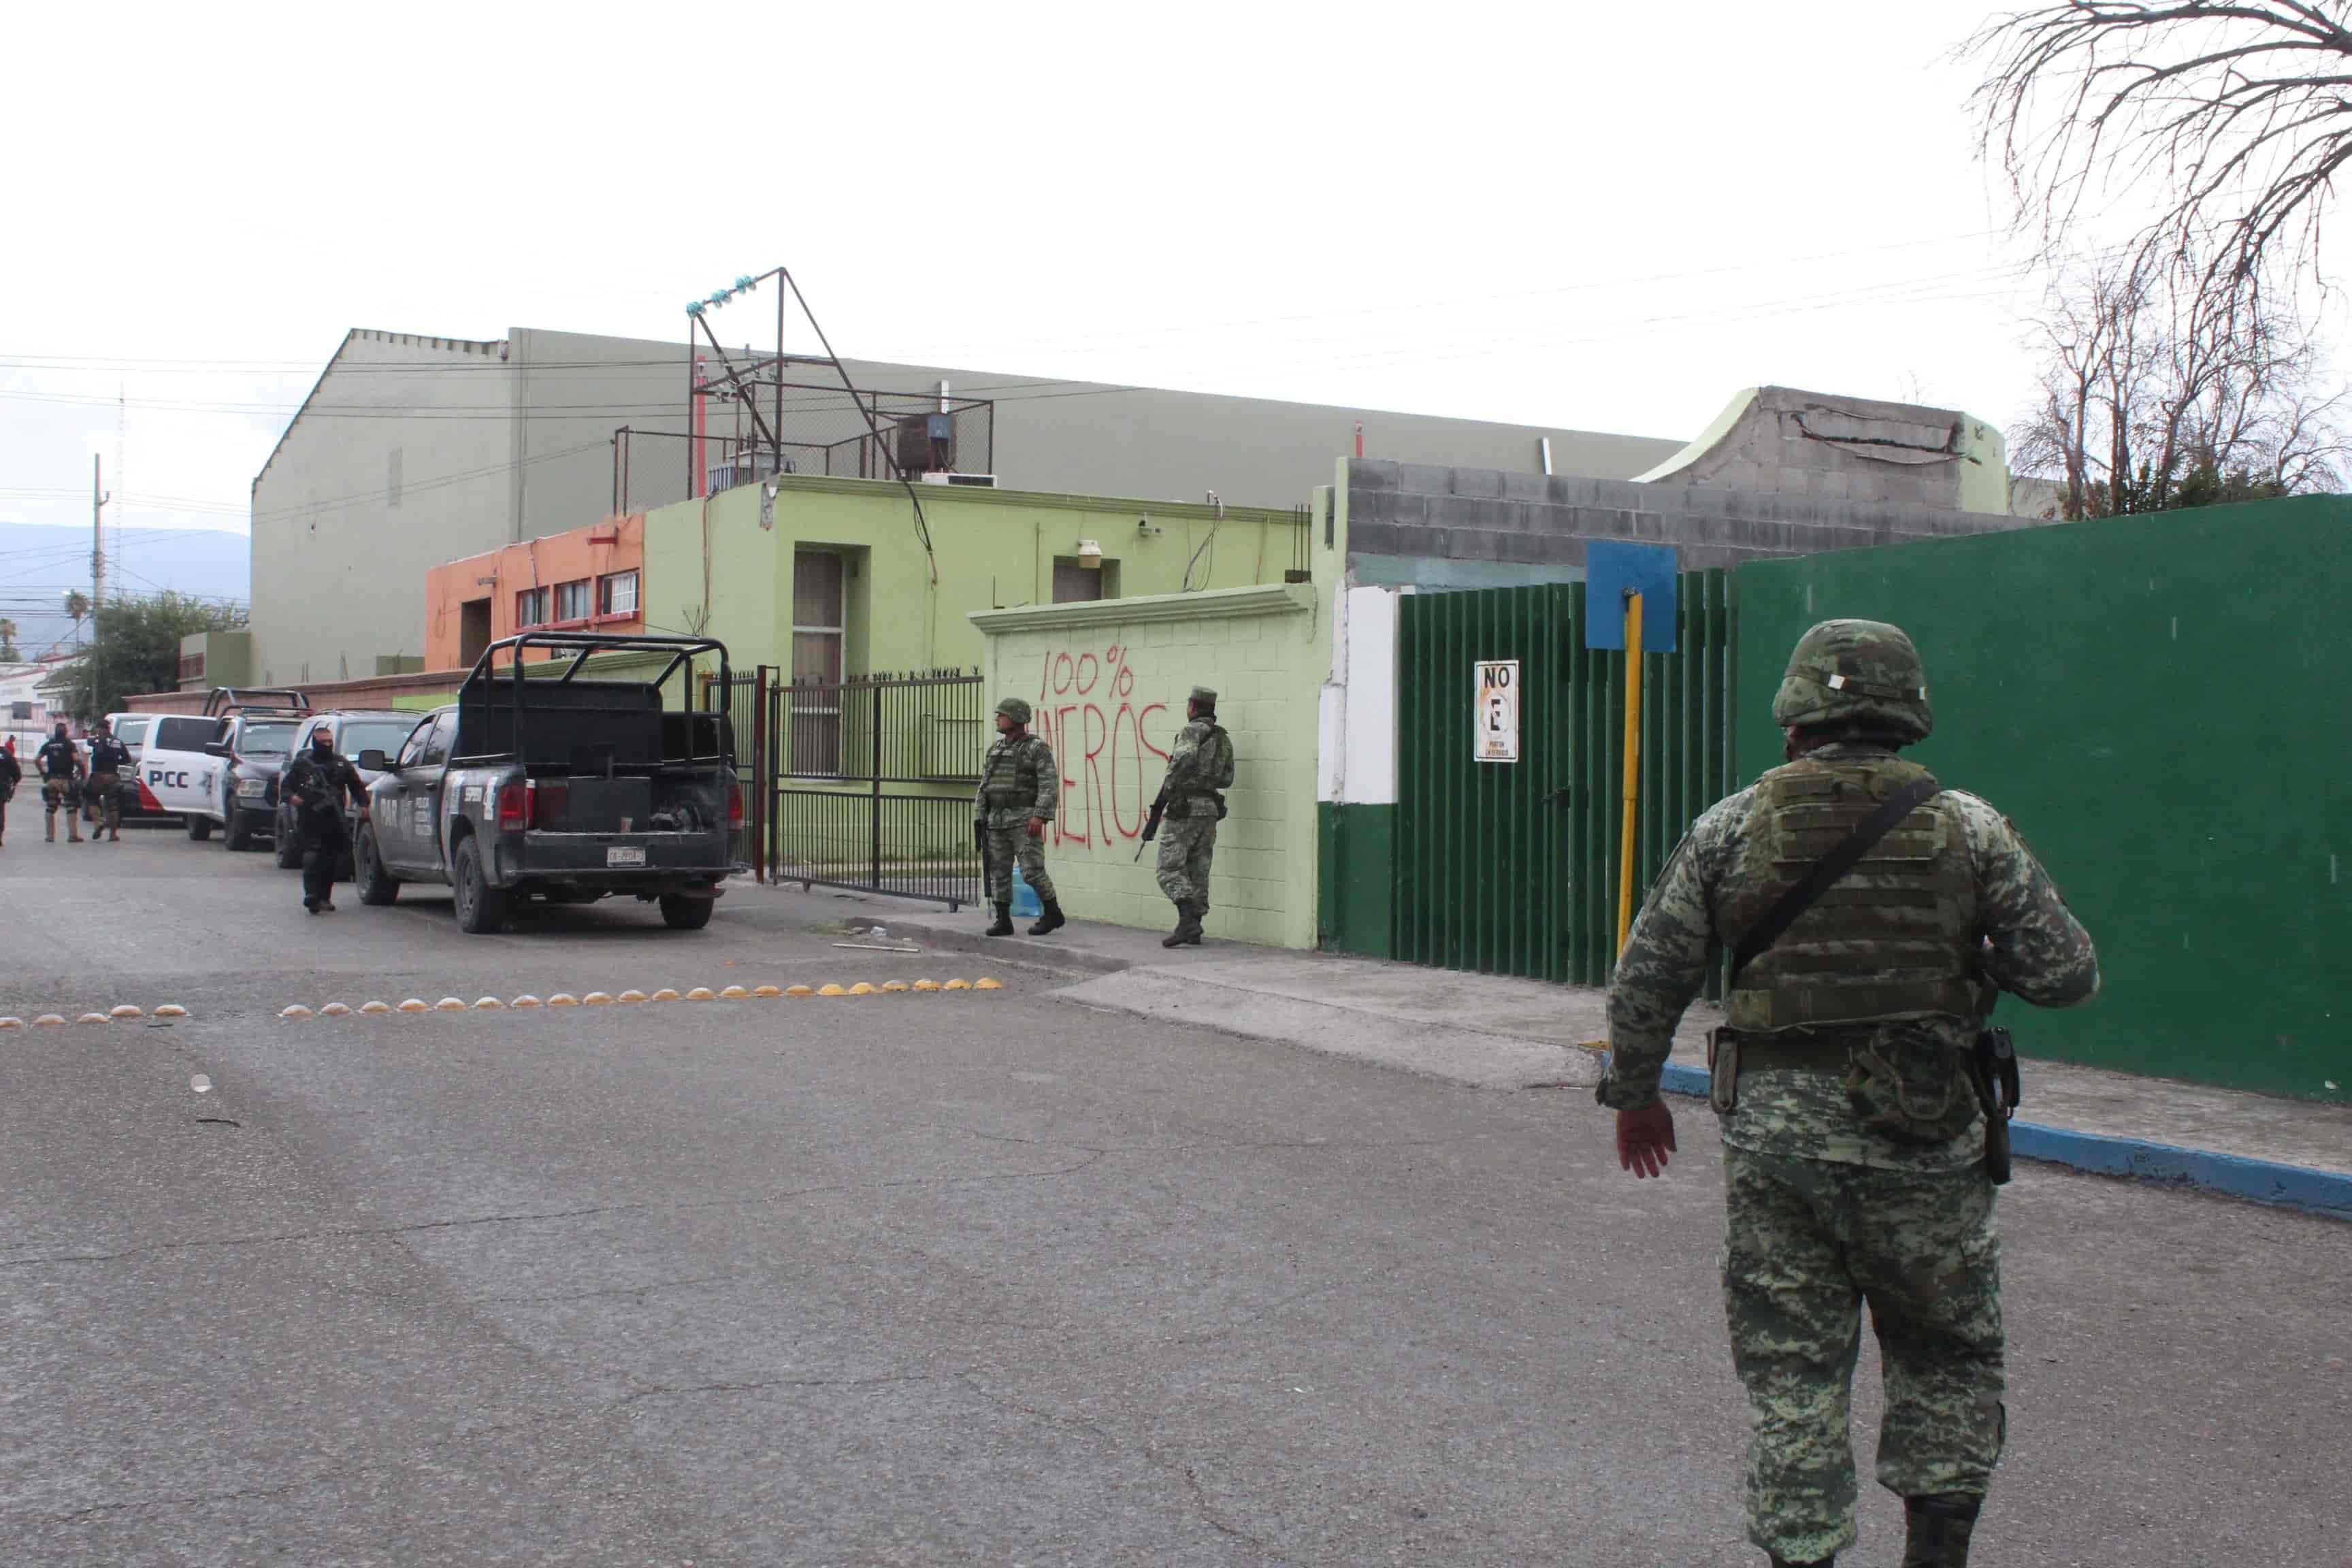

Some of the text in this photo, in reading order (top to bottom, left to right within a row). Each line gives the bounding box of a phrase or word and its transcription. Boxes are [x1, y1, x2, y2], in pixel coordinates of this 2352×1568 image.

[1040, 643, 1133, 701] 100%
[1484, 667, 1509, 688] NO
[149, 770, 189, 788] PCC
[1025, 703, 1173, 849] NEROS
